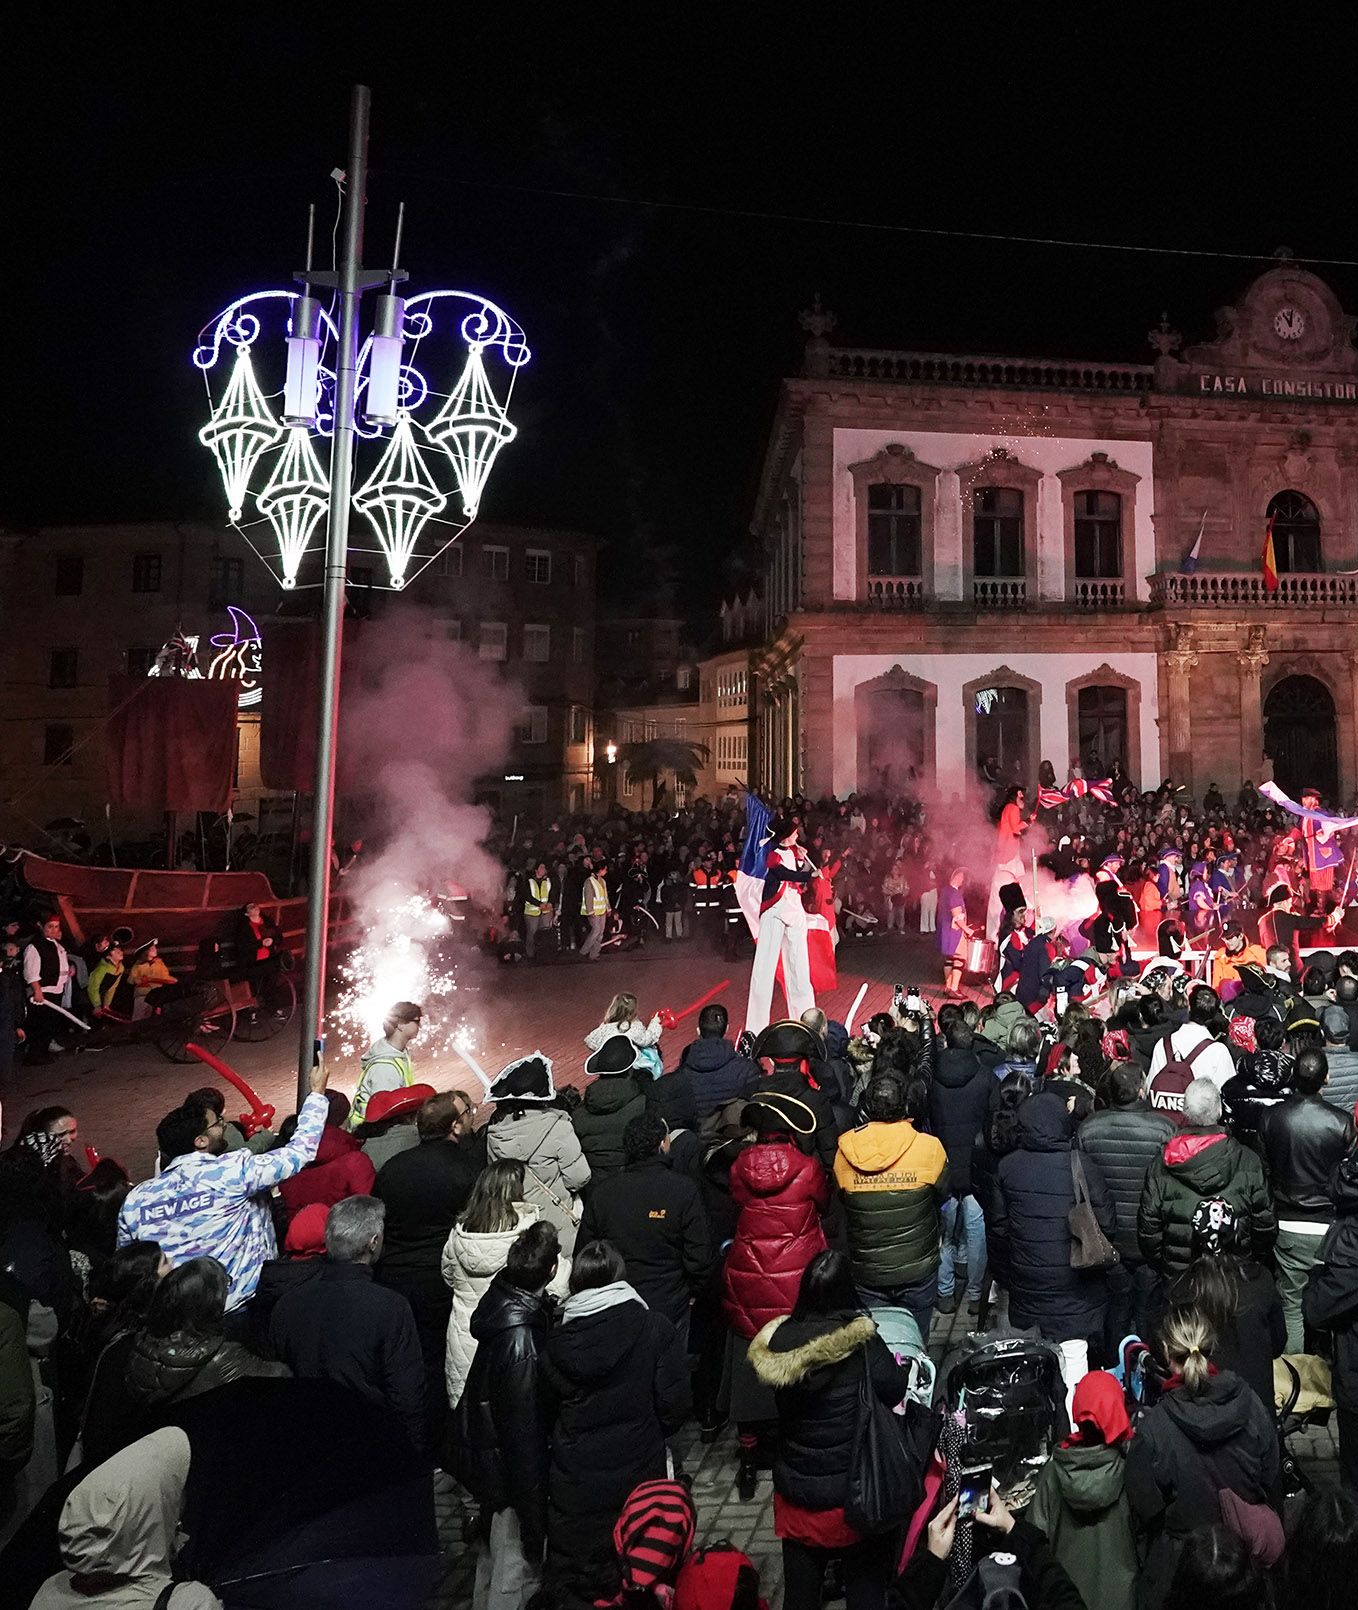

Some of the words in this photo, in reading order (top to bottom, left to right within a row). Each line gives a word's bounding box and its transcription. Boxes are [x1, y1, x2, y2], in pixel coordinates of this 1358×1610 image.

[1200, 375, 1247, 393] CASA
[1149, 1089, 1184, 1111] VANS
[145, 1201, 178, 1220] NEW
[179, 1193, 211, 1213] AGE
